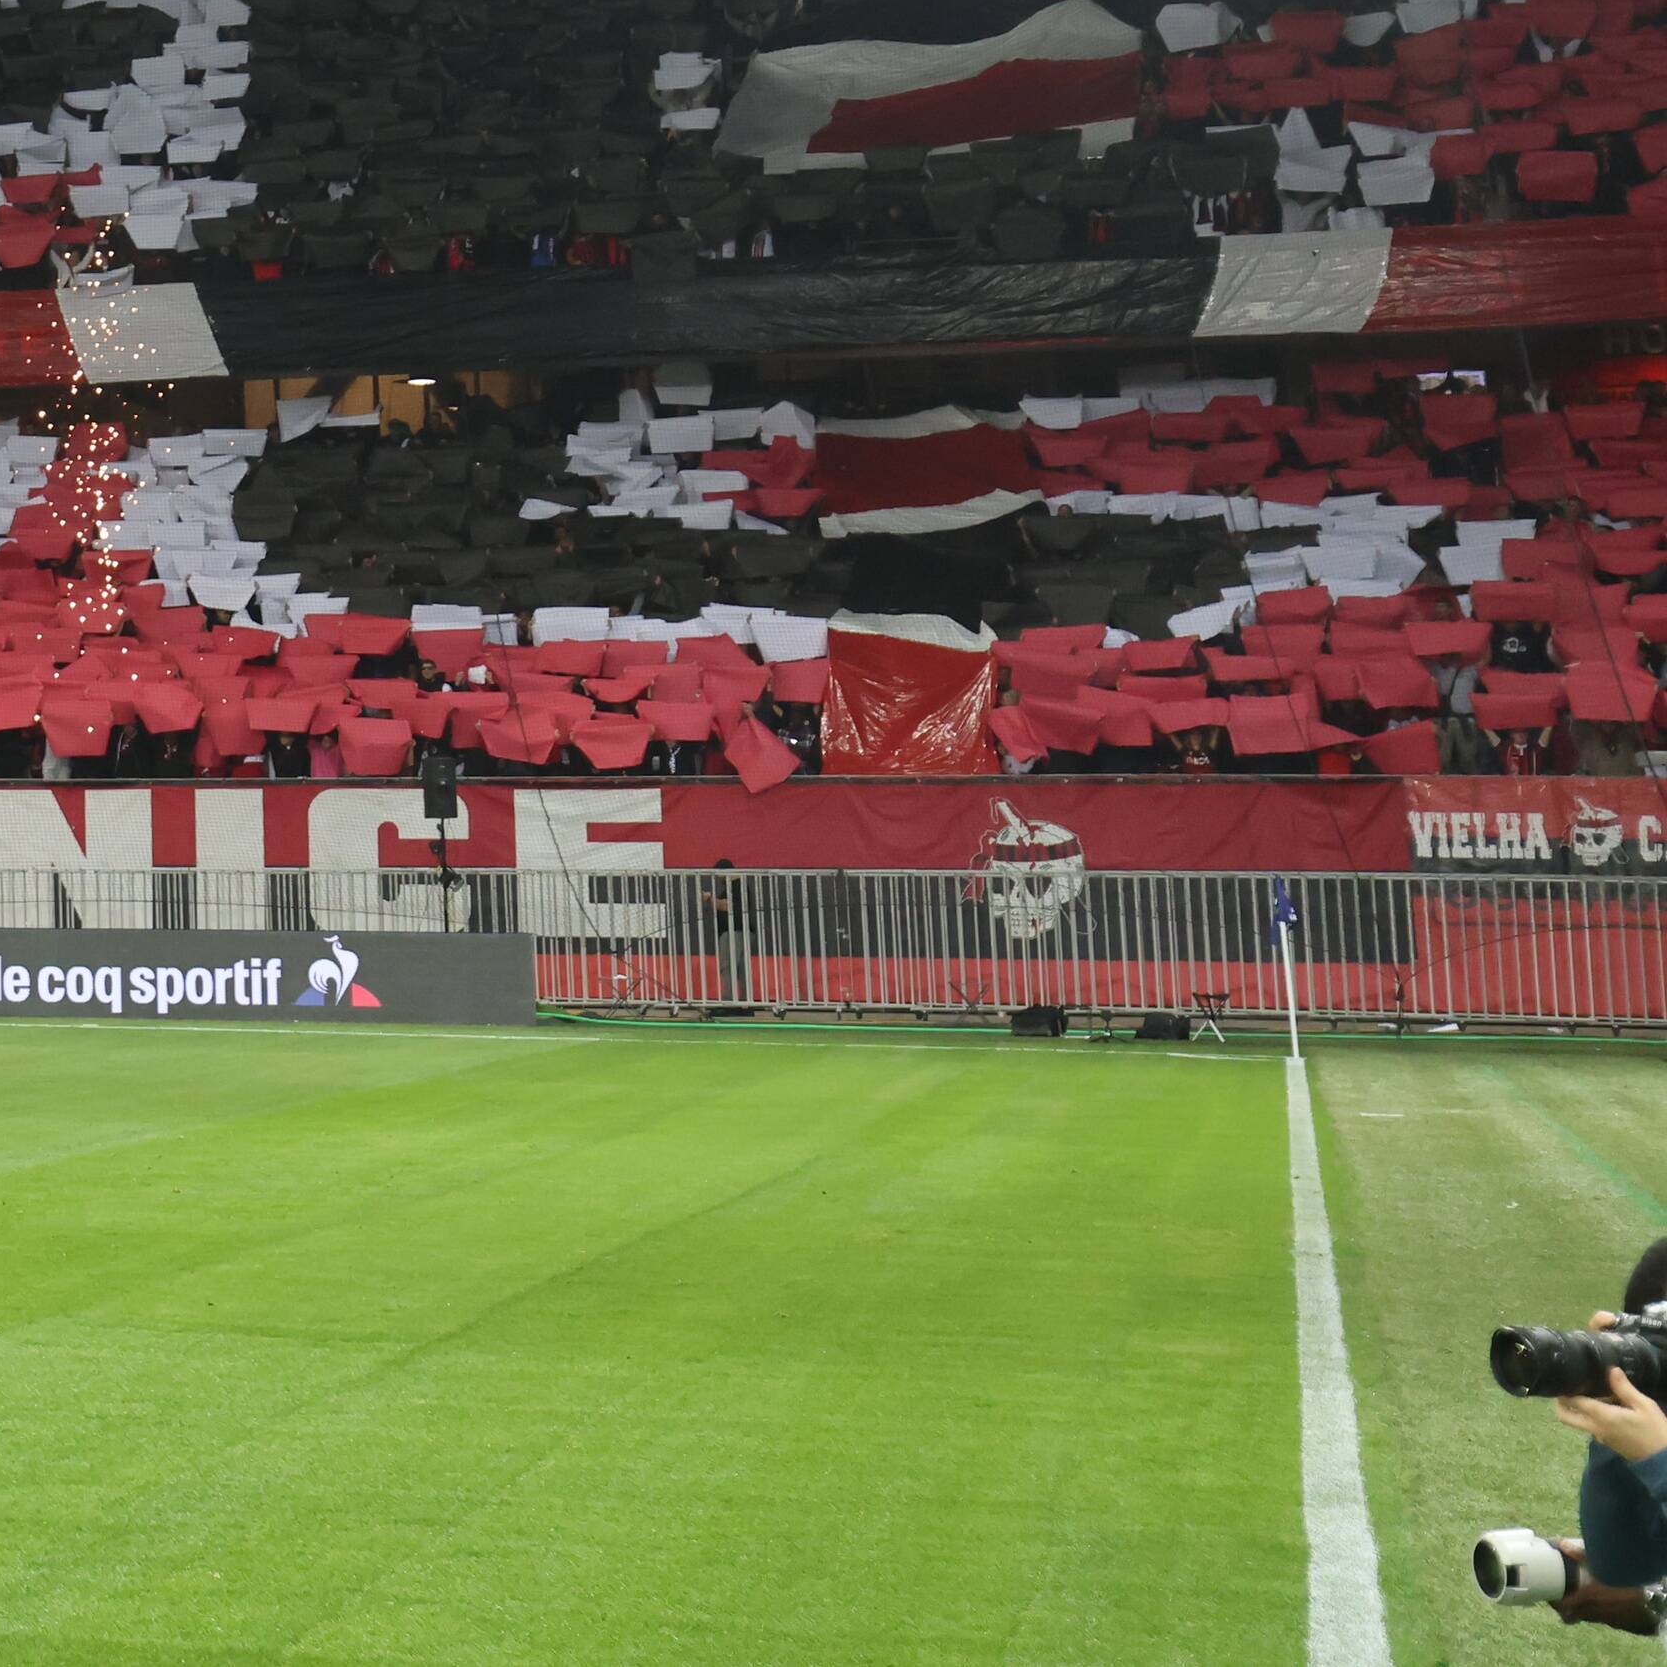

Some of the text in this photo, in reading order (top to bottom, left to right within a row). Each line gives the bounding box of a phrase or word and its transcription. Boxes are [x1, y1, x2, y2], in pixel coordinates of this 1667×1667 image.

[1407, 810, 1552, 860] VIELHA
[38, 965, 122, 1014] coq
[129, 957, 284, 1014] sportif
